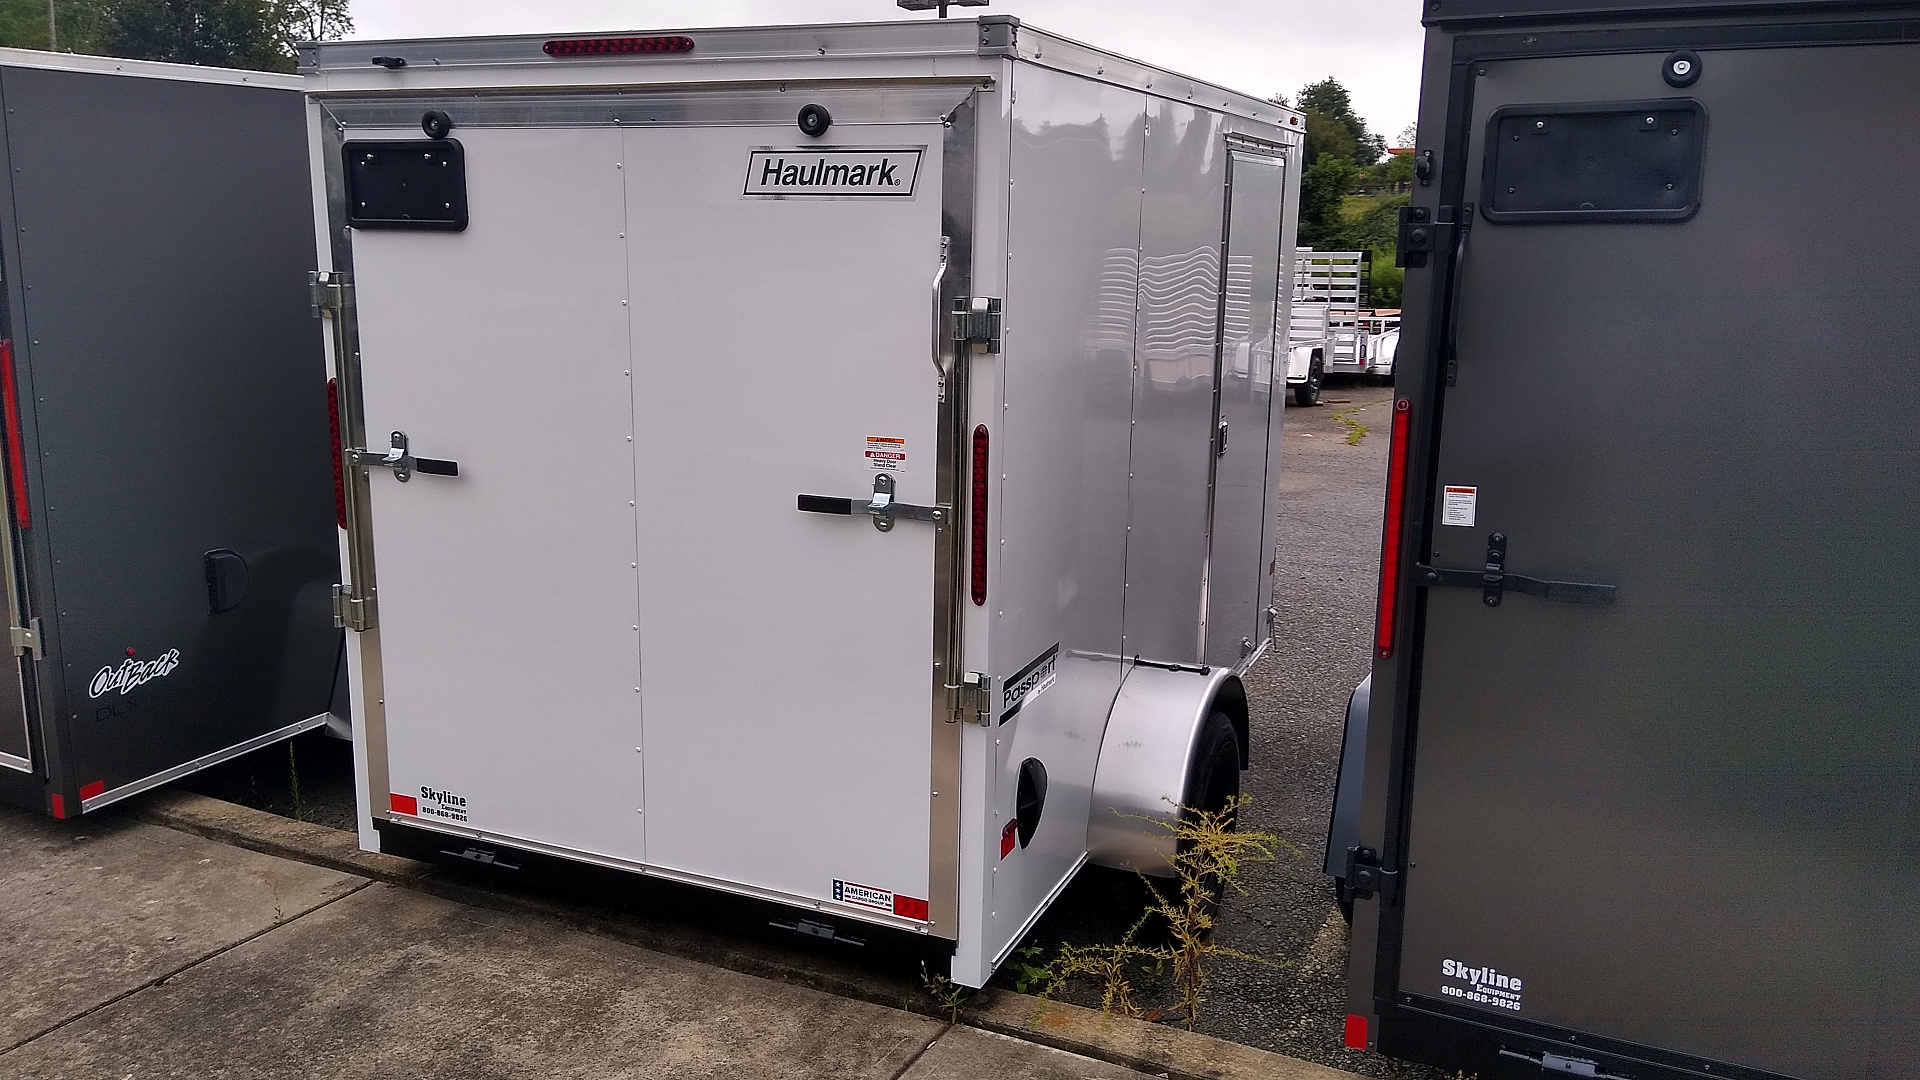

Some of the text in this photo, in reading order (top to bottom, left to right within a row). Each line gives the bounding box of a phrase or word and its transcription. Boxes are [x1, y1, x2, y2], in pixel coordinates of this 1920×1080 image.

[875, 452, 901, 460] DANGER
[96, 700, 137, 721] DLX
[420, 786, 467, 807] Skyline
[844, 886, 891, 902] AMERICAN
[1442, 959, 1522, 991] Skyline
[1441, 985, 1521, 1011] 800-868-9826
